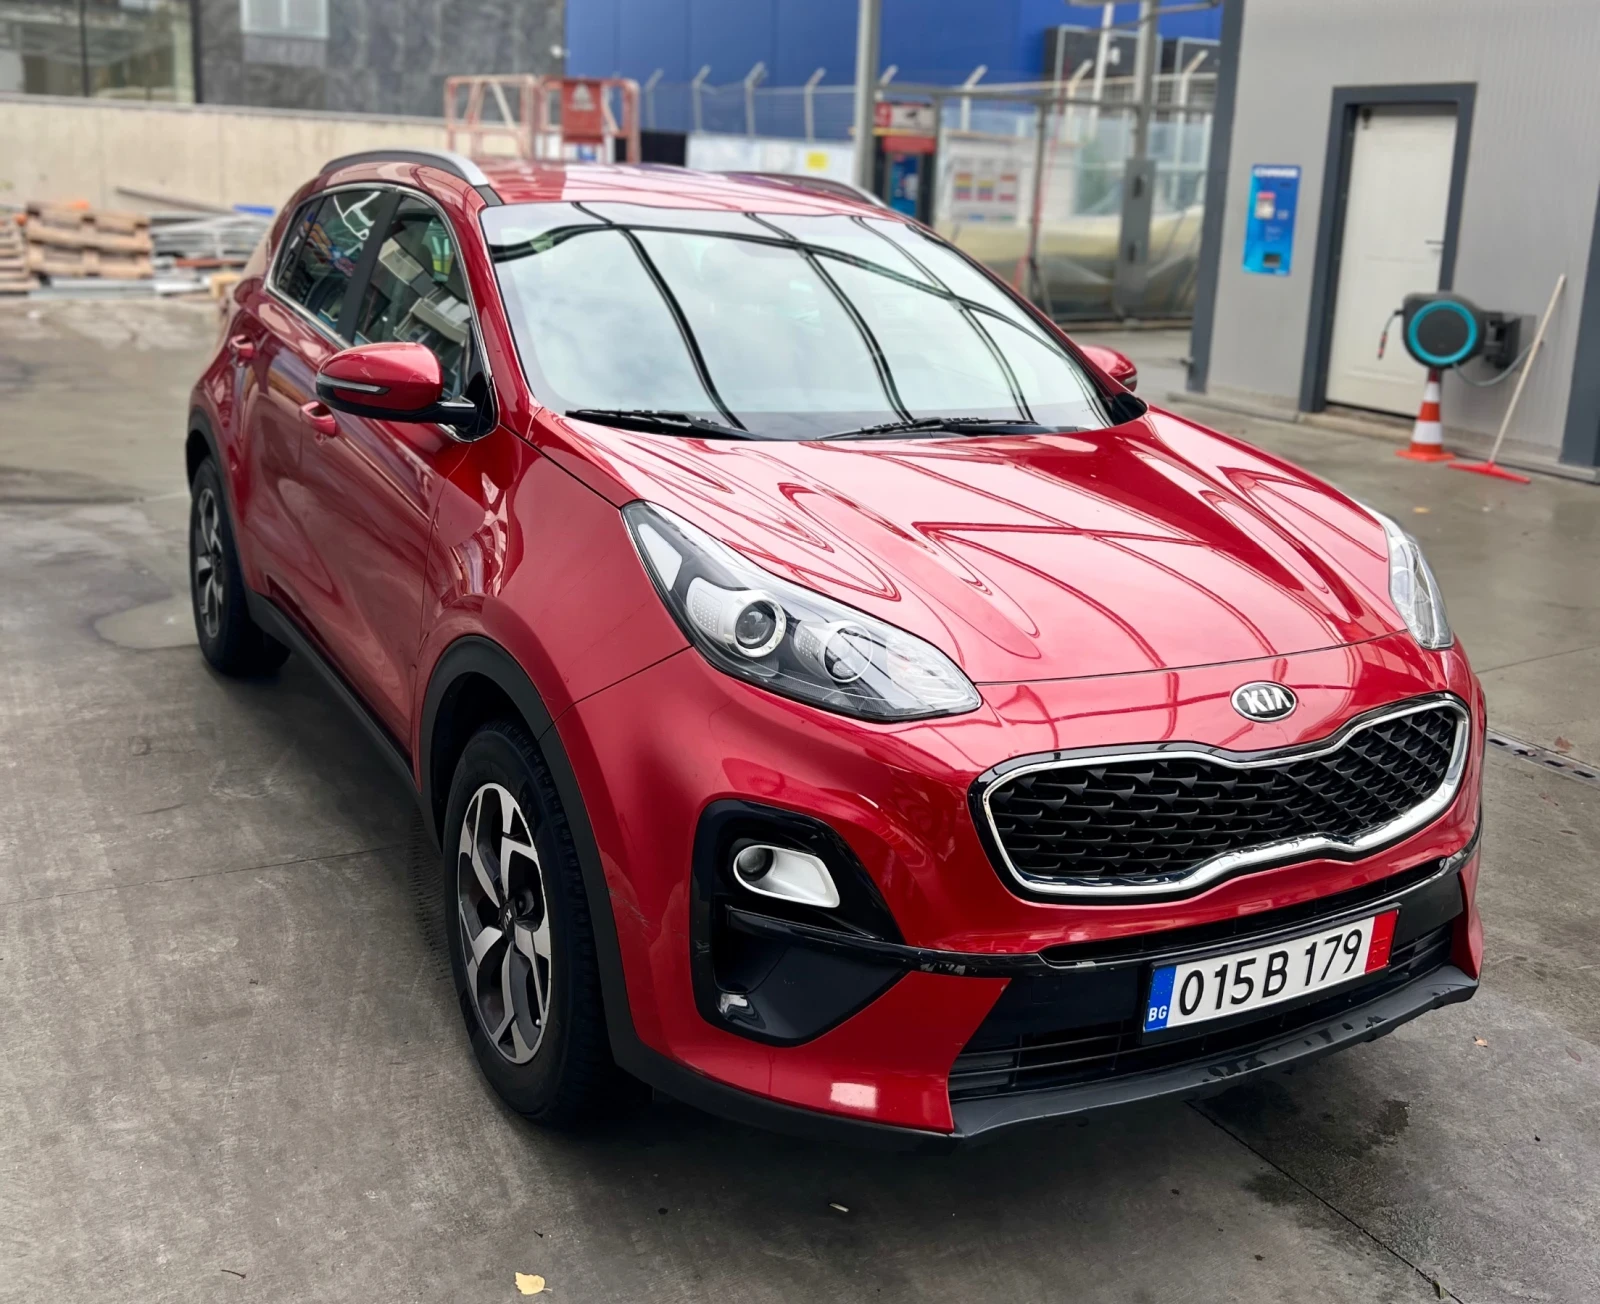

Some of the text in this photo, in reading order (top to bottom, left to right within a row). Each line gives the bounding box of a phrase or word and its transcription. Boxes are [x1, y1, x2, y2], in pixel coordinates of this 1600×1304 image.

[1241, 687, 1292, 714] KIA
[1304, 929, 1363, 987] 179
[1148, 1005, 1168, 1021] BG
